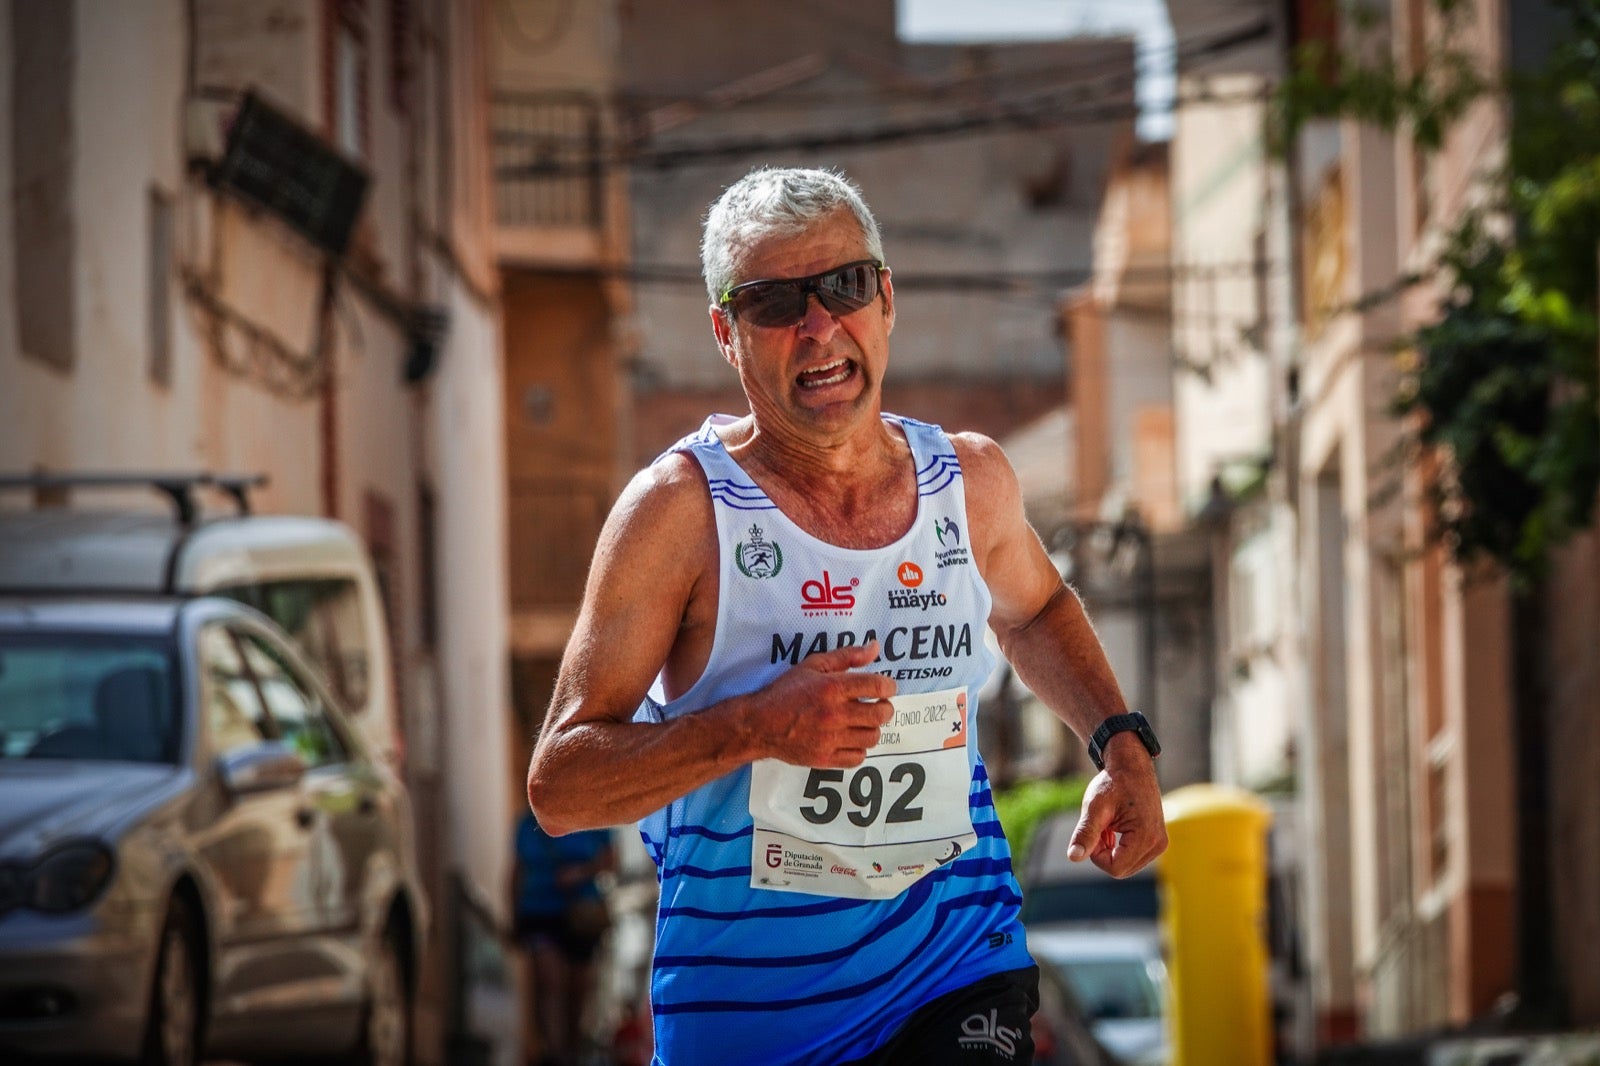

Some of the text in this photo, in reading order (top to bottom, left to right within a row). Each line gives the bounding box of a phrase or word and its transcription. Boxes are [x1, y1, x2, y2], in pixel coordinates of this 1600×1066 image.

[888, 588, 917, 598] grupo
[888, 590, 947, 611] mayfo
[923, 704, 947, 723] 2022
[799, 762, 926, 828] 592
[784, 850, 823, 862] Diputación
[793, 860, 823, 870] Granada
